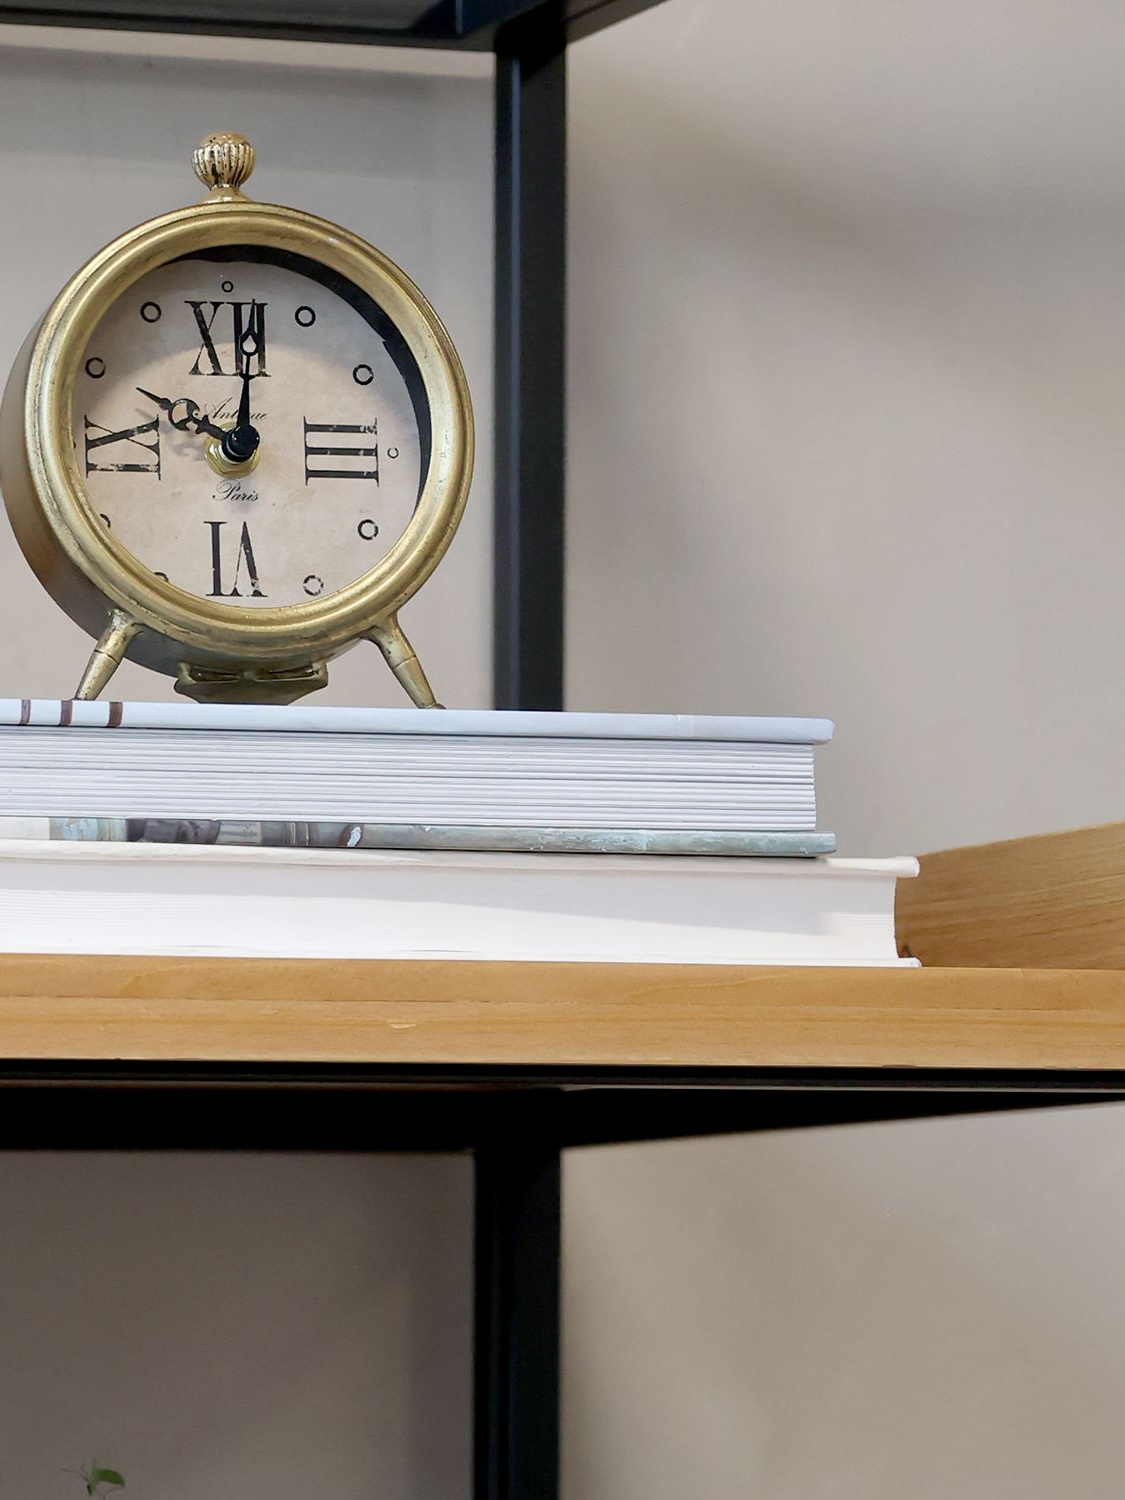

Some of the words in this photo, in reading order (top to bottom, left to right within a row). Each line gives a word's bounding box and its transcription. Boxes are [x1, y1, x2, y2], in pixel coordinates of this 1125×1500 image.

[184, 300, 272, 377] XII
[203, 396, 268, 421] Antue
[84, 413, 162, 481] IX
[303, 415, 380, 487] III
[213, 479, 259, 502] Paris
[203, 520, 268, 598] VI
